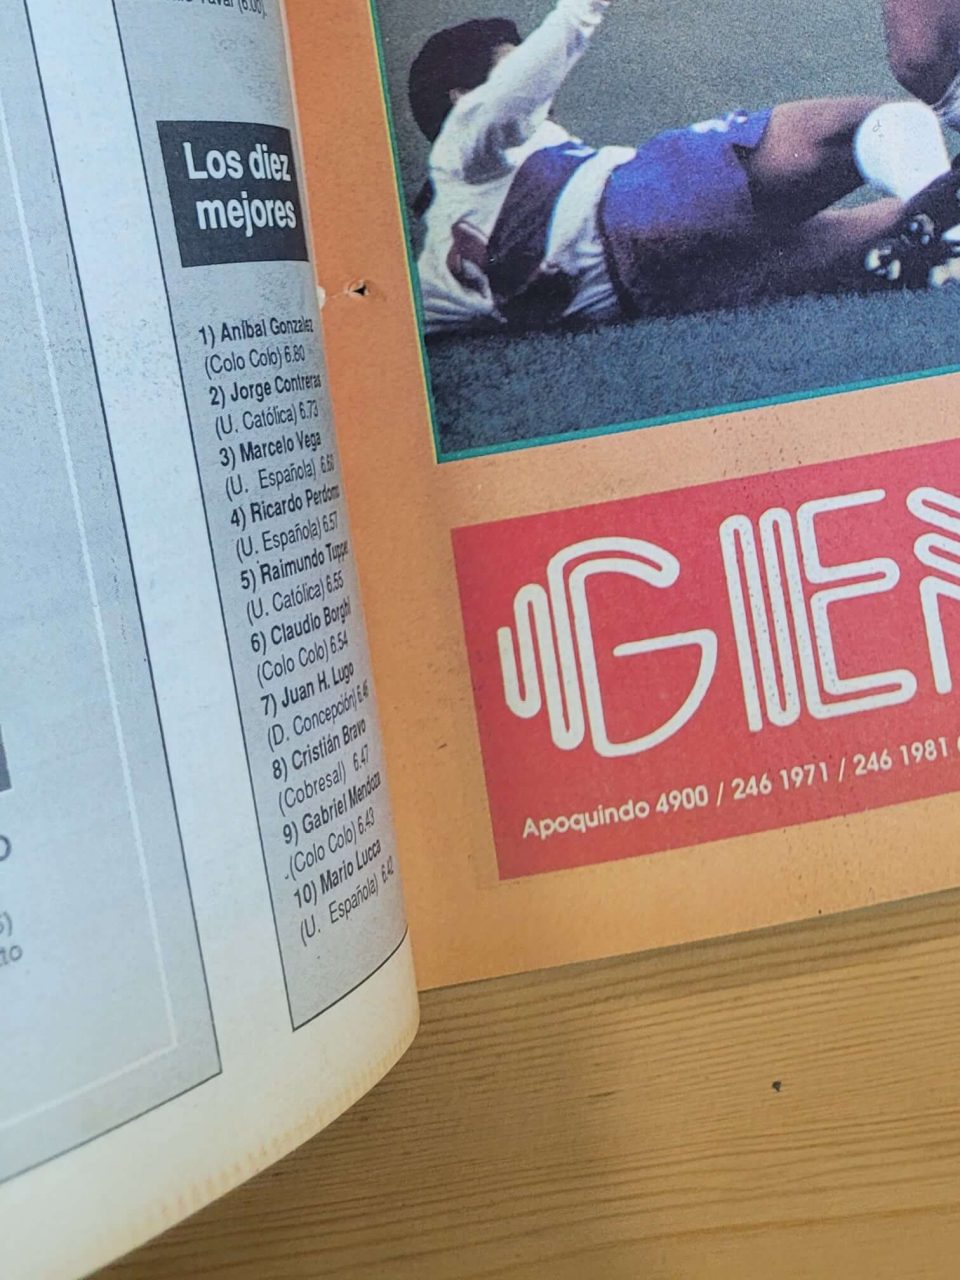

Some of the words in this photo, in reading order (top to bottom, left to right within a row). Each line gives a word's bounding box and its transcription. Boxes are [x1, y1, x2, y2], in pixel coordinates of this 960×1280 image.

[182, 141, 243, 180] Los
[249, 142, 291, 182] diez
[196, 192, 296, 238] mejores
[198, 326, 216, 347] 1)
[220, 316, 267, 345] Aníbal
[205, 353, 245, 380] (Colo
[249, 348, 283, 370] Colo)
[209, 385, 226, 408] 2)
[230, 378, 272, 406] Jorge
[275, 372, 321, 394] Contreras
[251, 631, 267, 655] 6)
[271, 612, 321, 645] Claudio
[260, 693, 277, 719] 7)
[282, 681, 314, 708] Juan
[318, 672, 332, 693] H.
[333, 662, 354, 685] Lugo
[522, 799, 650, 840] Apoquindo
[656, 784, 709, 814] 4900
[732, 775, 772, 800] 246
[781, 762, 829, 790] 1971
[854, 751, 892, 777] 246
[900, 737, 948, 765] 1981
